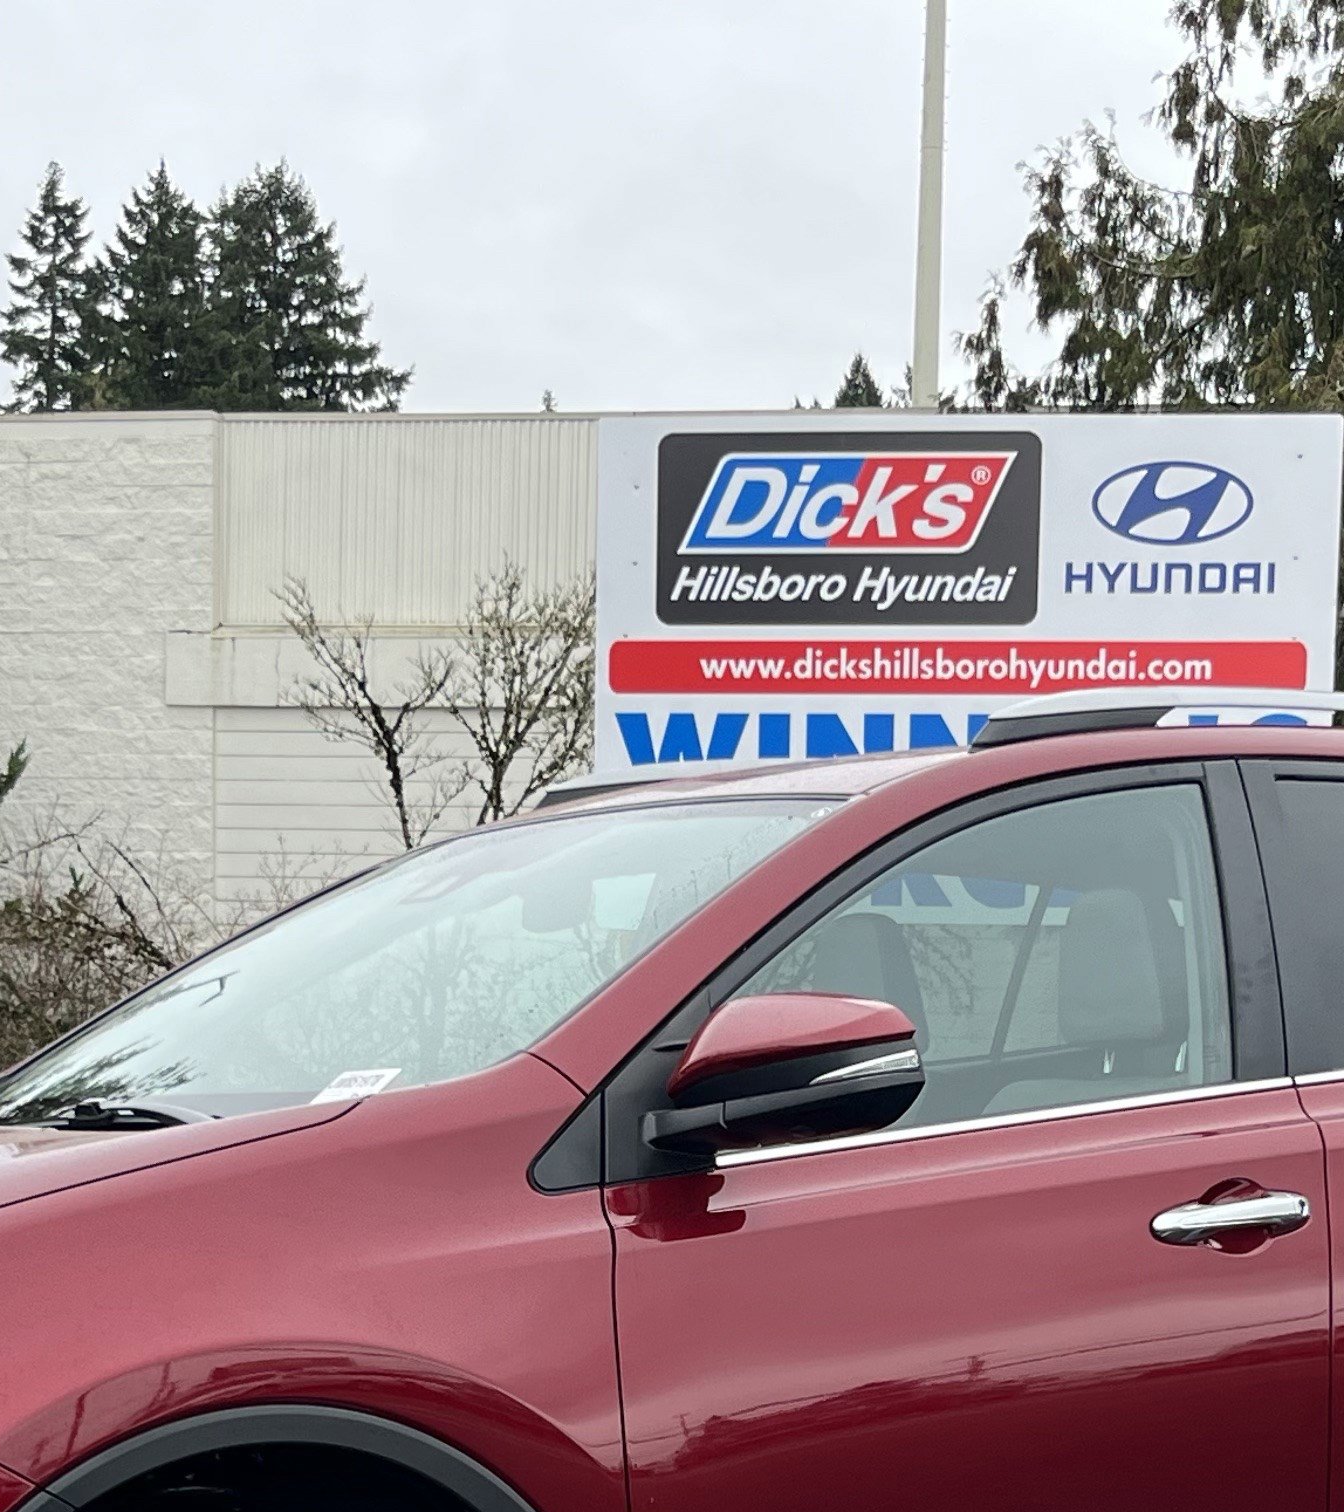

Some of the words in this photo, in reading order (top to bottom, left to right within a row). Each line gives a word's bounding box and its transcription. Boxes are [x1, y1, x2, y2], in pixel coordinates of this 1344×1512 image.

[705, 464, 974, 540] Dick's
[670, 565, 847, 602] Hillsboro
[852, 565, 1018, 611] Hyundai
[1064, 562, 1276, 595] HYUNDAI
[700, 647, 1213, 690] www.dickshillsborohyundai.com
